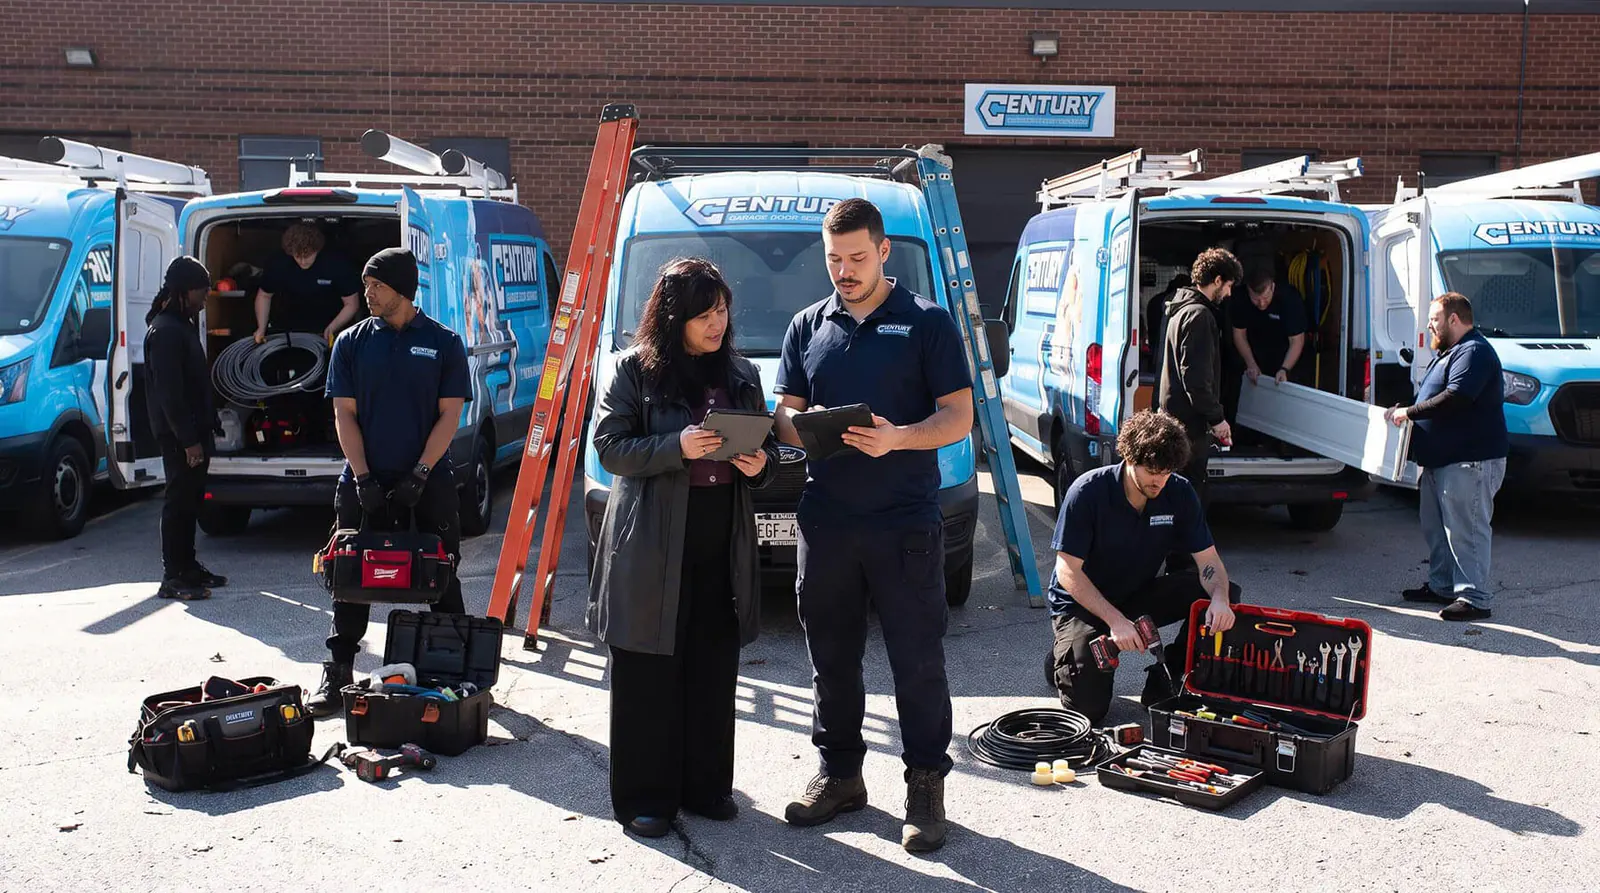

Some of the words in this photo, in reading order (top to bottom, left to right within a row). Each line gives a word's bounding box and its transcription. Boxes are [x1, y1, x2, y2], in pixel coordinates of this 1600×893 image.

[979, 93, 1100, 126] CENTURY
[683, 195, 842, 226] CENTUR
[491, 244, 538, 310] CENTURY
